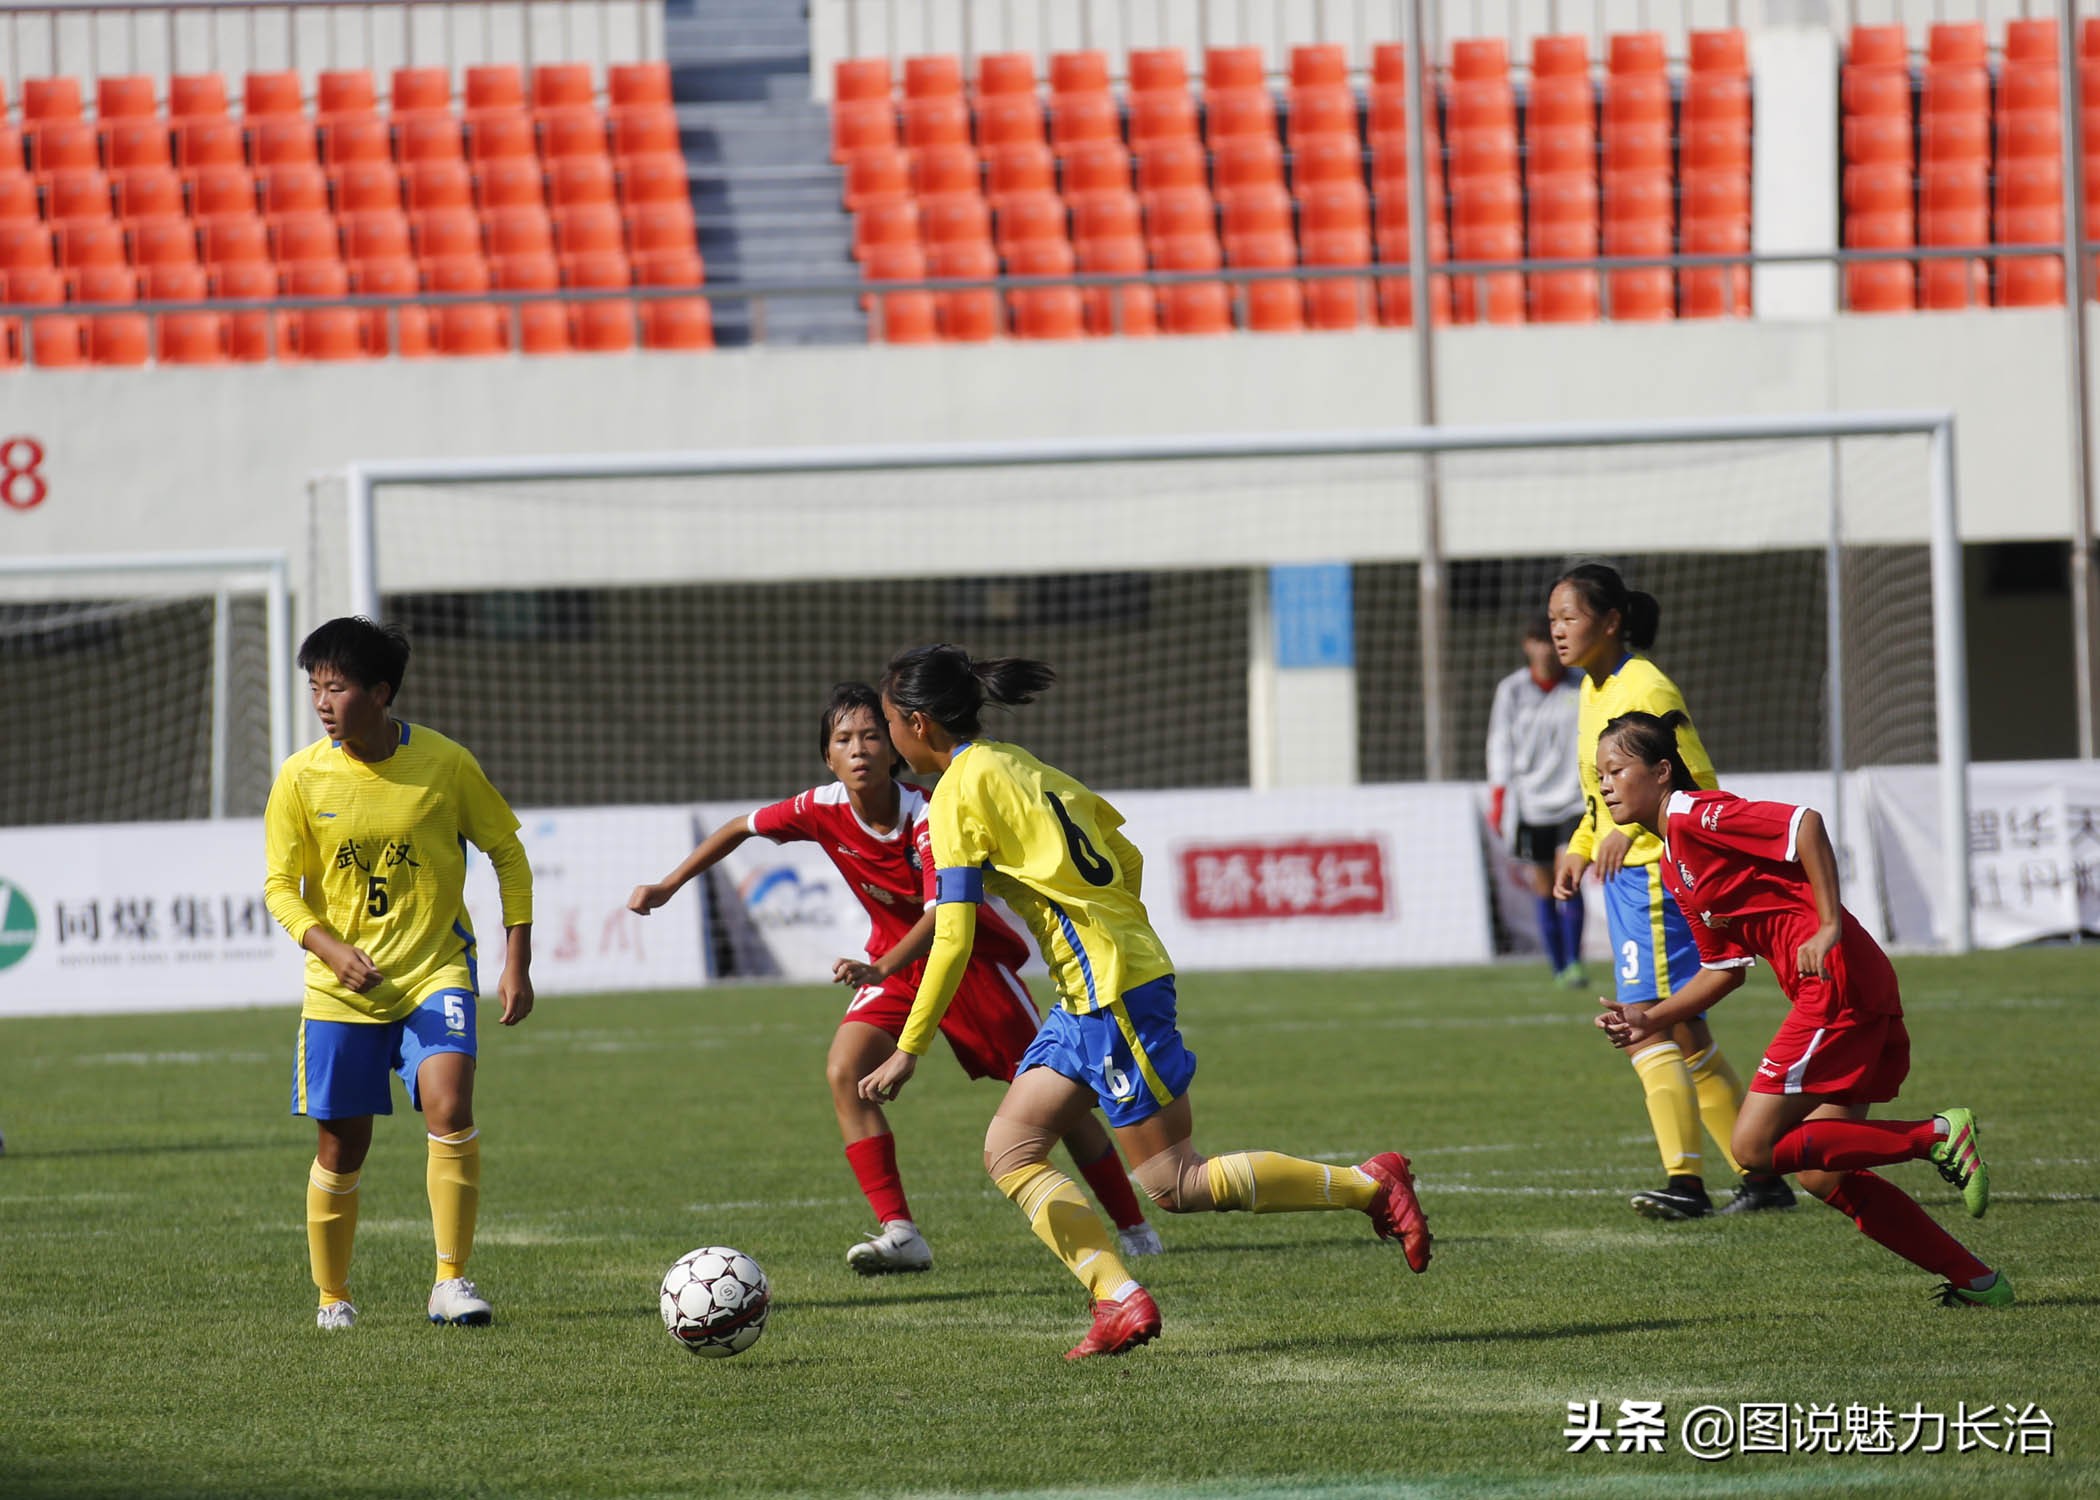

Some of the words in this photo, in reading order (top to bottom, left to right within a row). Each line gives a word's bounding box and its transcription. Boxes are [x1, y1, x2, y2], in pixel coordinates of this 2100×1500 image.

[336, 839, 420, 872] 武汉
[1044, 790, 1114, 887] 6
[368, 876, 389, 917] 5
[1621, 940, 1639, 979] 3
[443, 995, 466, 1031] 5
[1104, 1056, 1131, 1098] 6
